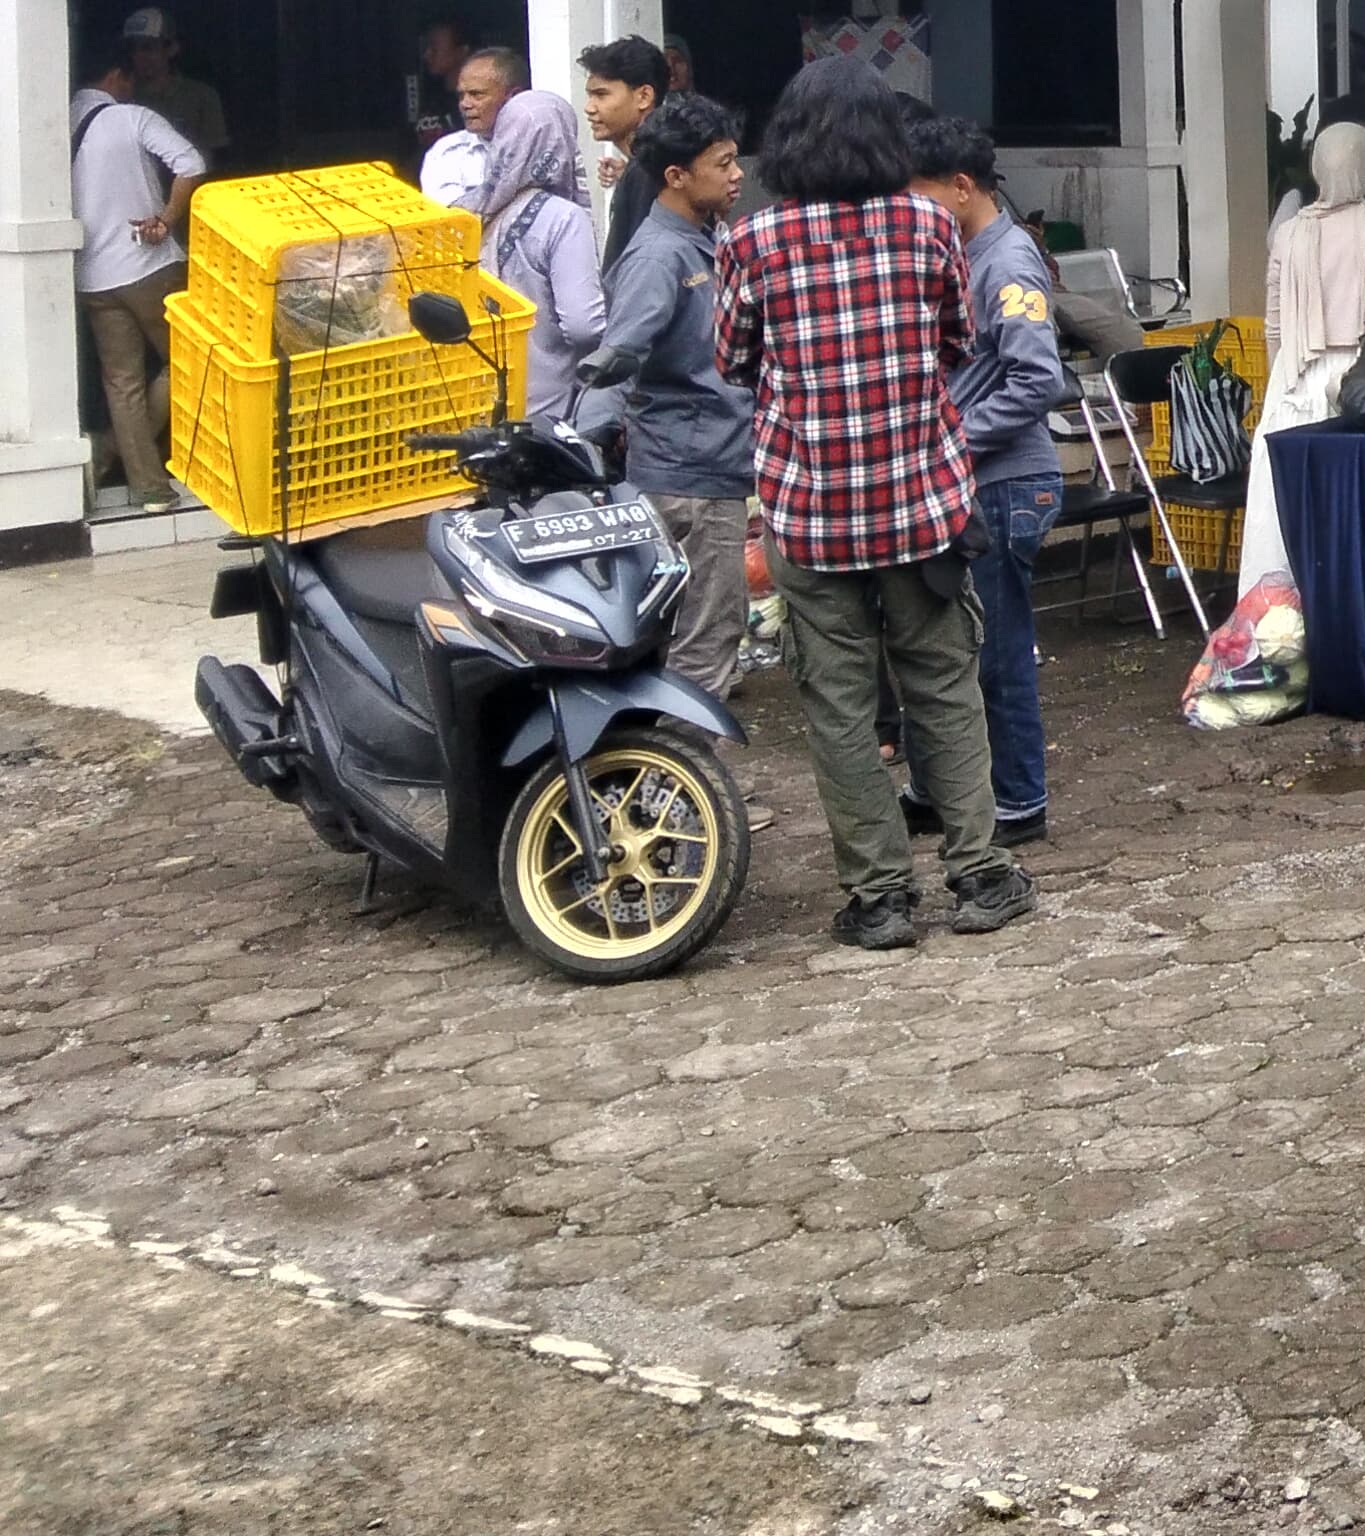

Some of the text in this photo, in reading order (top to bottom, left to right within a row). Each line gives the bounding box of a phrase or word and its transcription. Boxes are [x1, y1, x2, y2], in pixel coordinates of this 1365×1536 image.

[999, 283, 1048, 322] 23
[508, 525, 524, 542] F
[534, 514, 594, 538] 6993
[594, 527, 653, 546] 07 27
